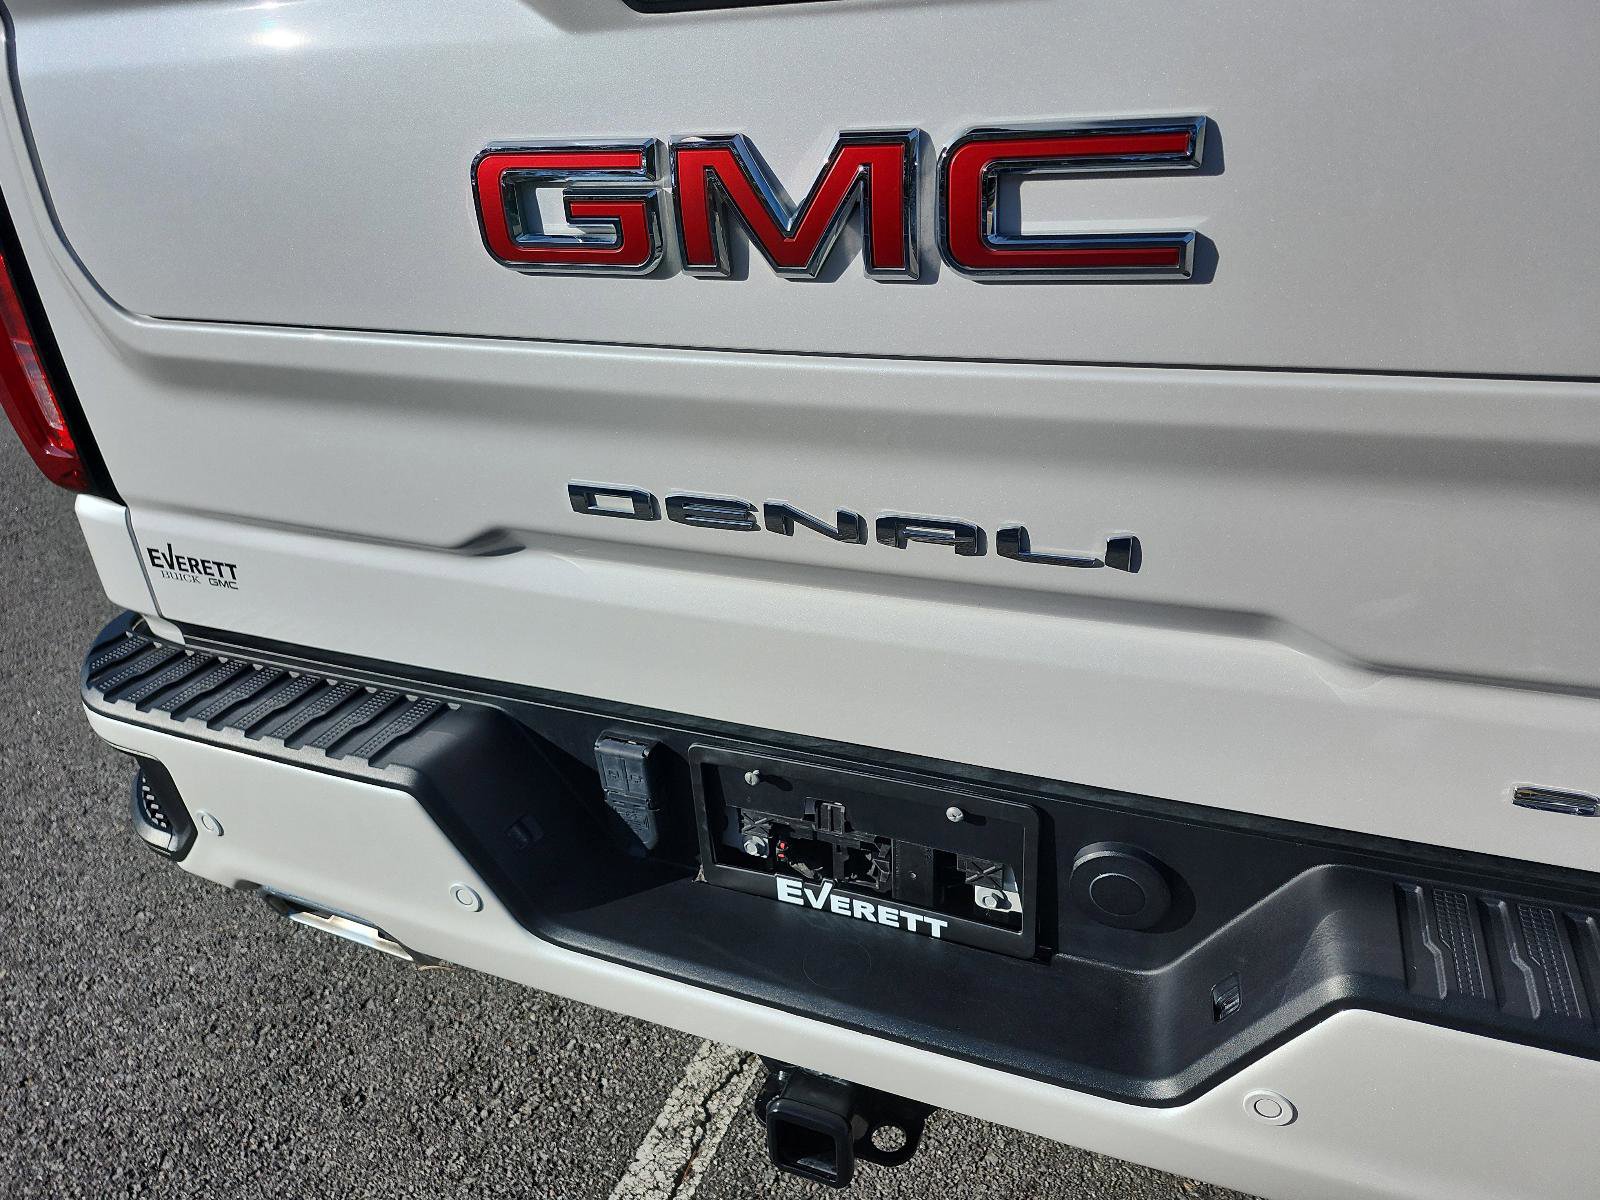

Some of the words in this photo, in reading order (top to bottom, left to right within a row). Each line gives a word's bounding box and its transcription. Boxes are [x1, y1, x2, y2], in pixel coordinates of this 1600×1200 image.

[471, 114, 1207, 283] GMC
[567, 480, 1143, 574] DENALI
[147, 542, 237, 580] EVERETT
[161, 570, 201, 584] BUICK
[208, 577, 239, 590] GMC
[776, 876, 948, 938] EVERETT
